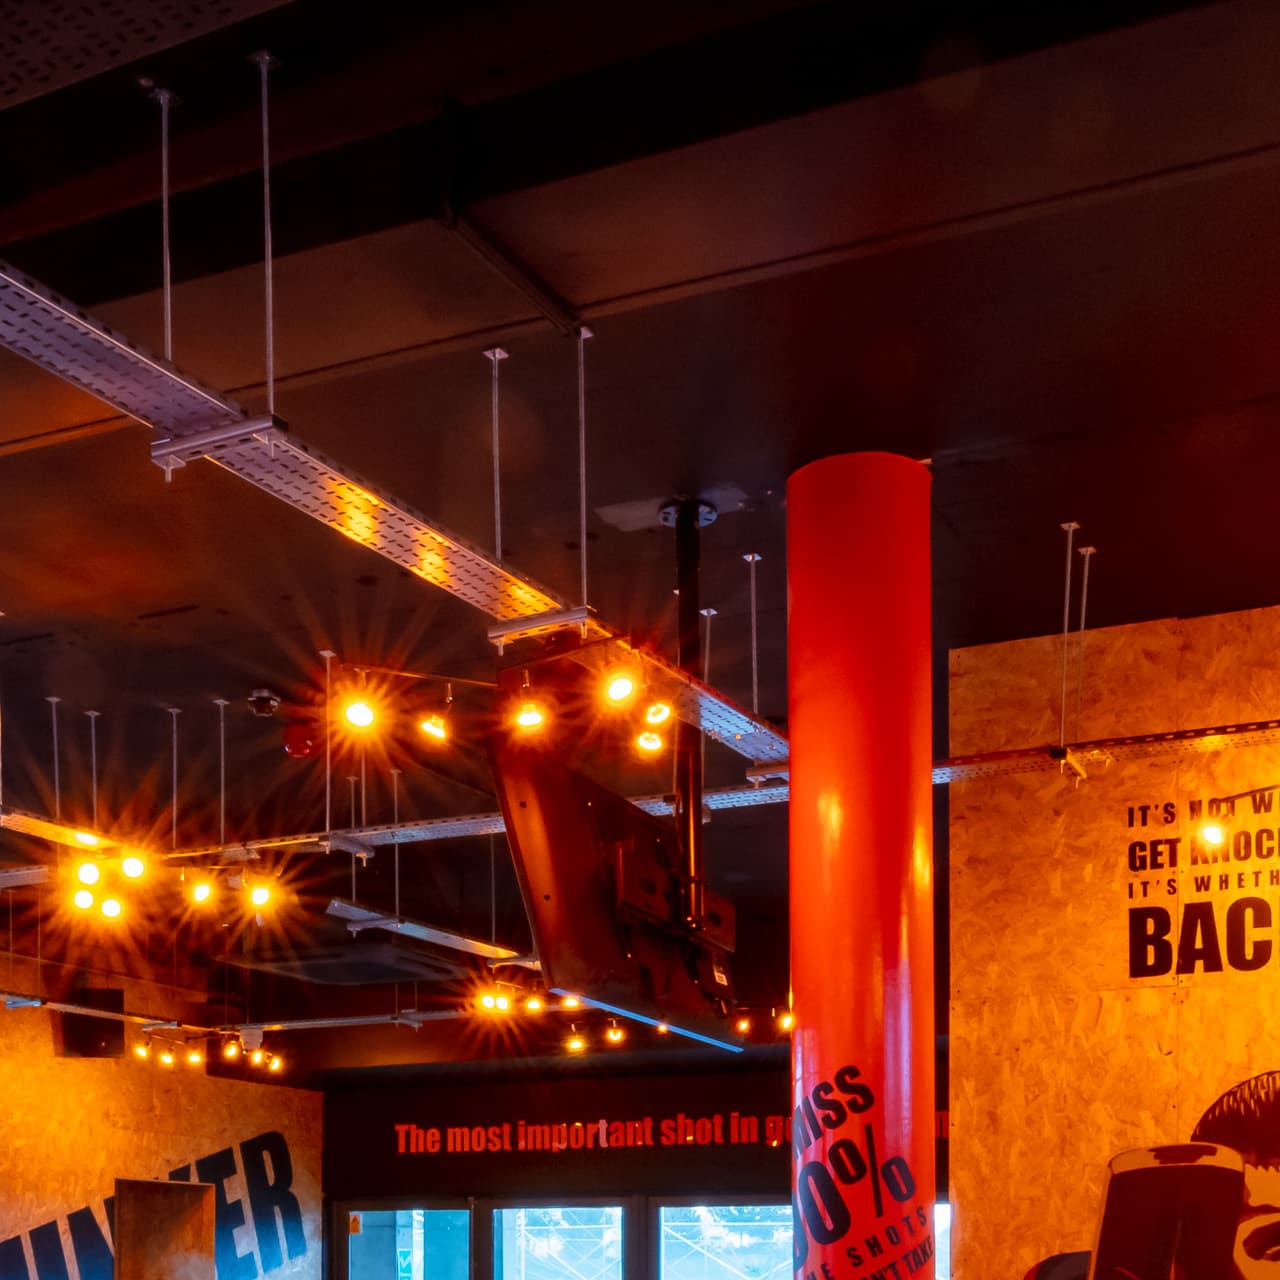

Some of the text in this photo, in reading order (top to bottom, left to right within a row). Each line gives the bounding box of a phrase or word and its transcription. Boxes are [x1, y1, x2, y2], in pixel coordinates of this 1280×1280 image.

[1127, 802, 1176, 828] IT'S
[1127, 837, 1181, 872] GET
[1127, 878, 1177, 899] IT'S
[394, 1123, 441, 1153] The
[447, 1122, 512, 1153] most
[517, 1117, 654, 1153] important
[660, 1113, 724, 1146] shot
[730, 1112, 759, 1144] in
[846, 1207, 927, 1267] SHOTS
